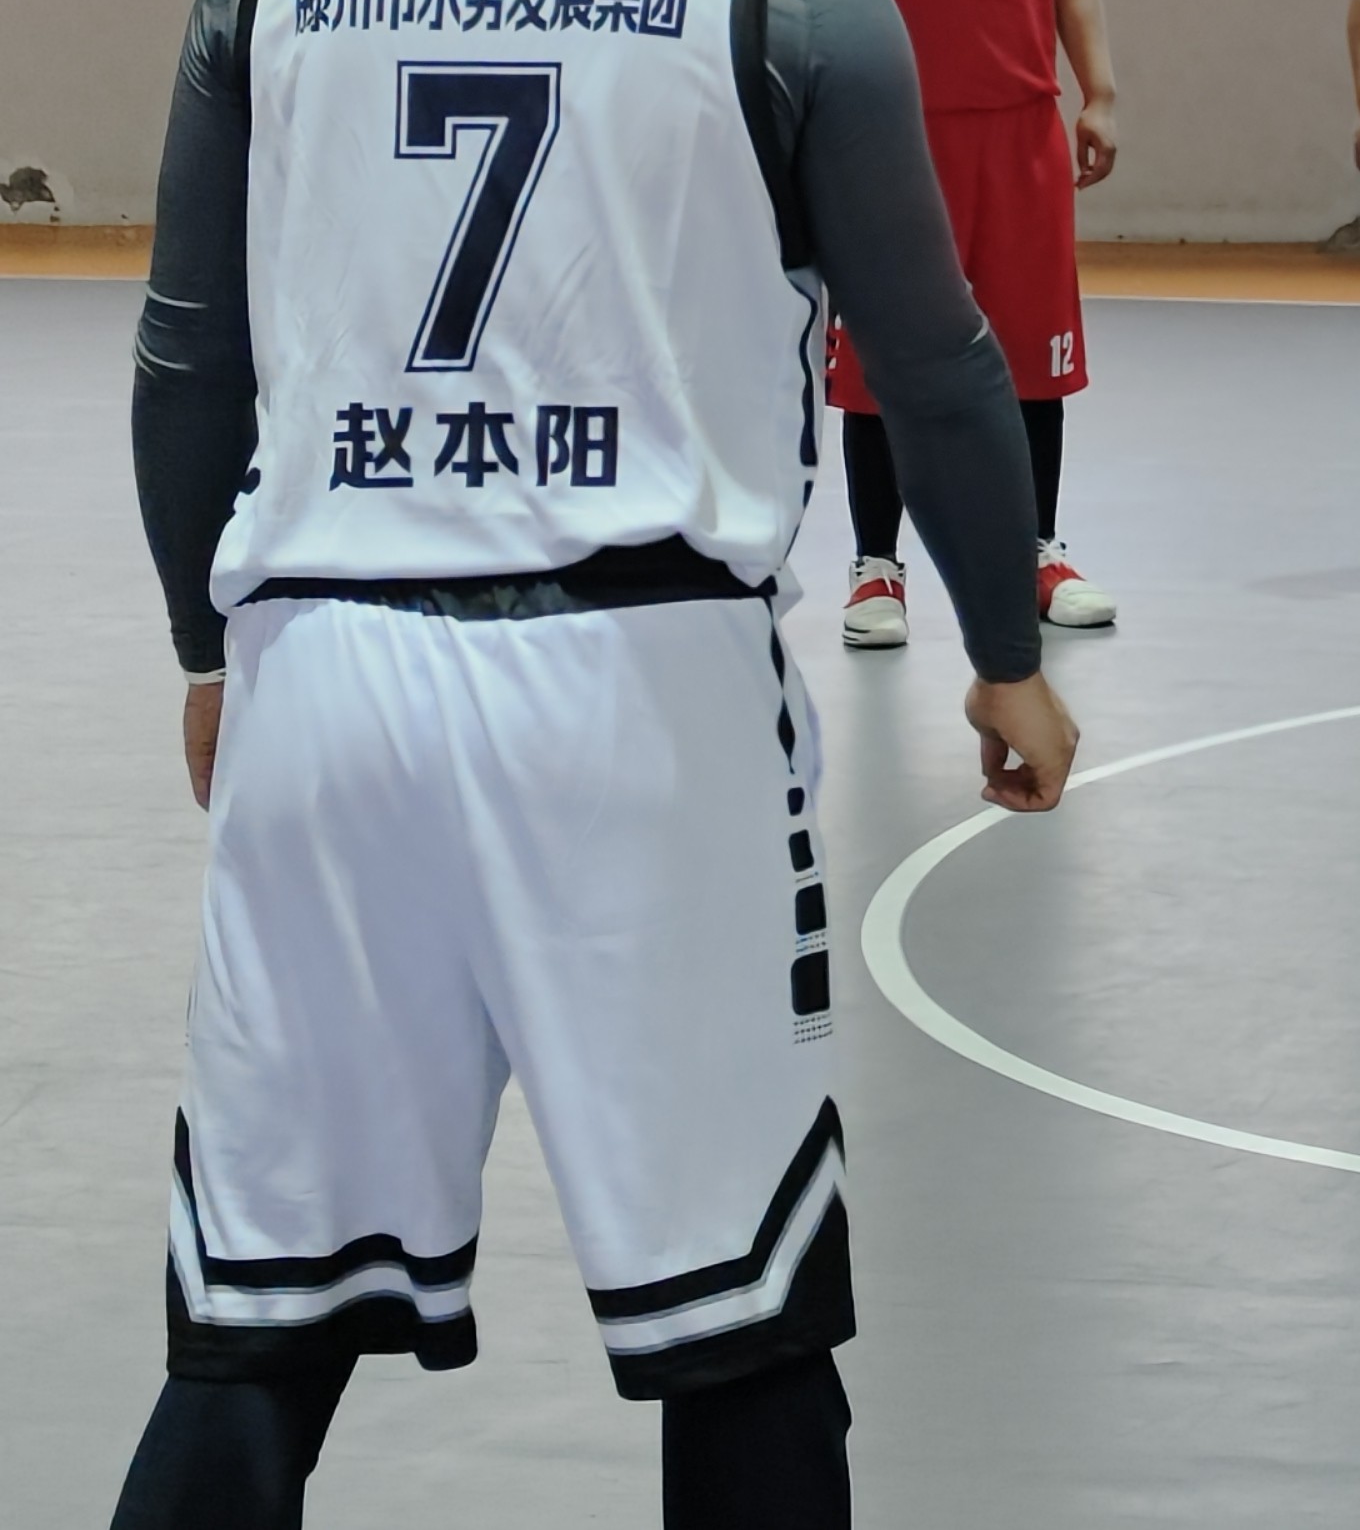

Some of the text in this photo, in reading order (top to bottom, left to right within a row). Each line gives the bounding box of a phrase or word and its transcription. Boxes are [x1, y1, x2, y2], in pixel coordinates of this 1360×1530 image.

[394, 60, 562, 372] 7
[1049, 331, 1075, 378] 12
[328, 401, 619, 492] 赵本阳
